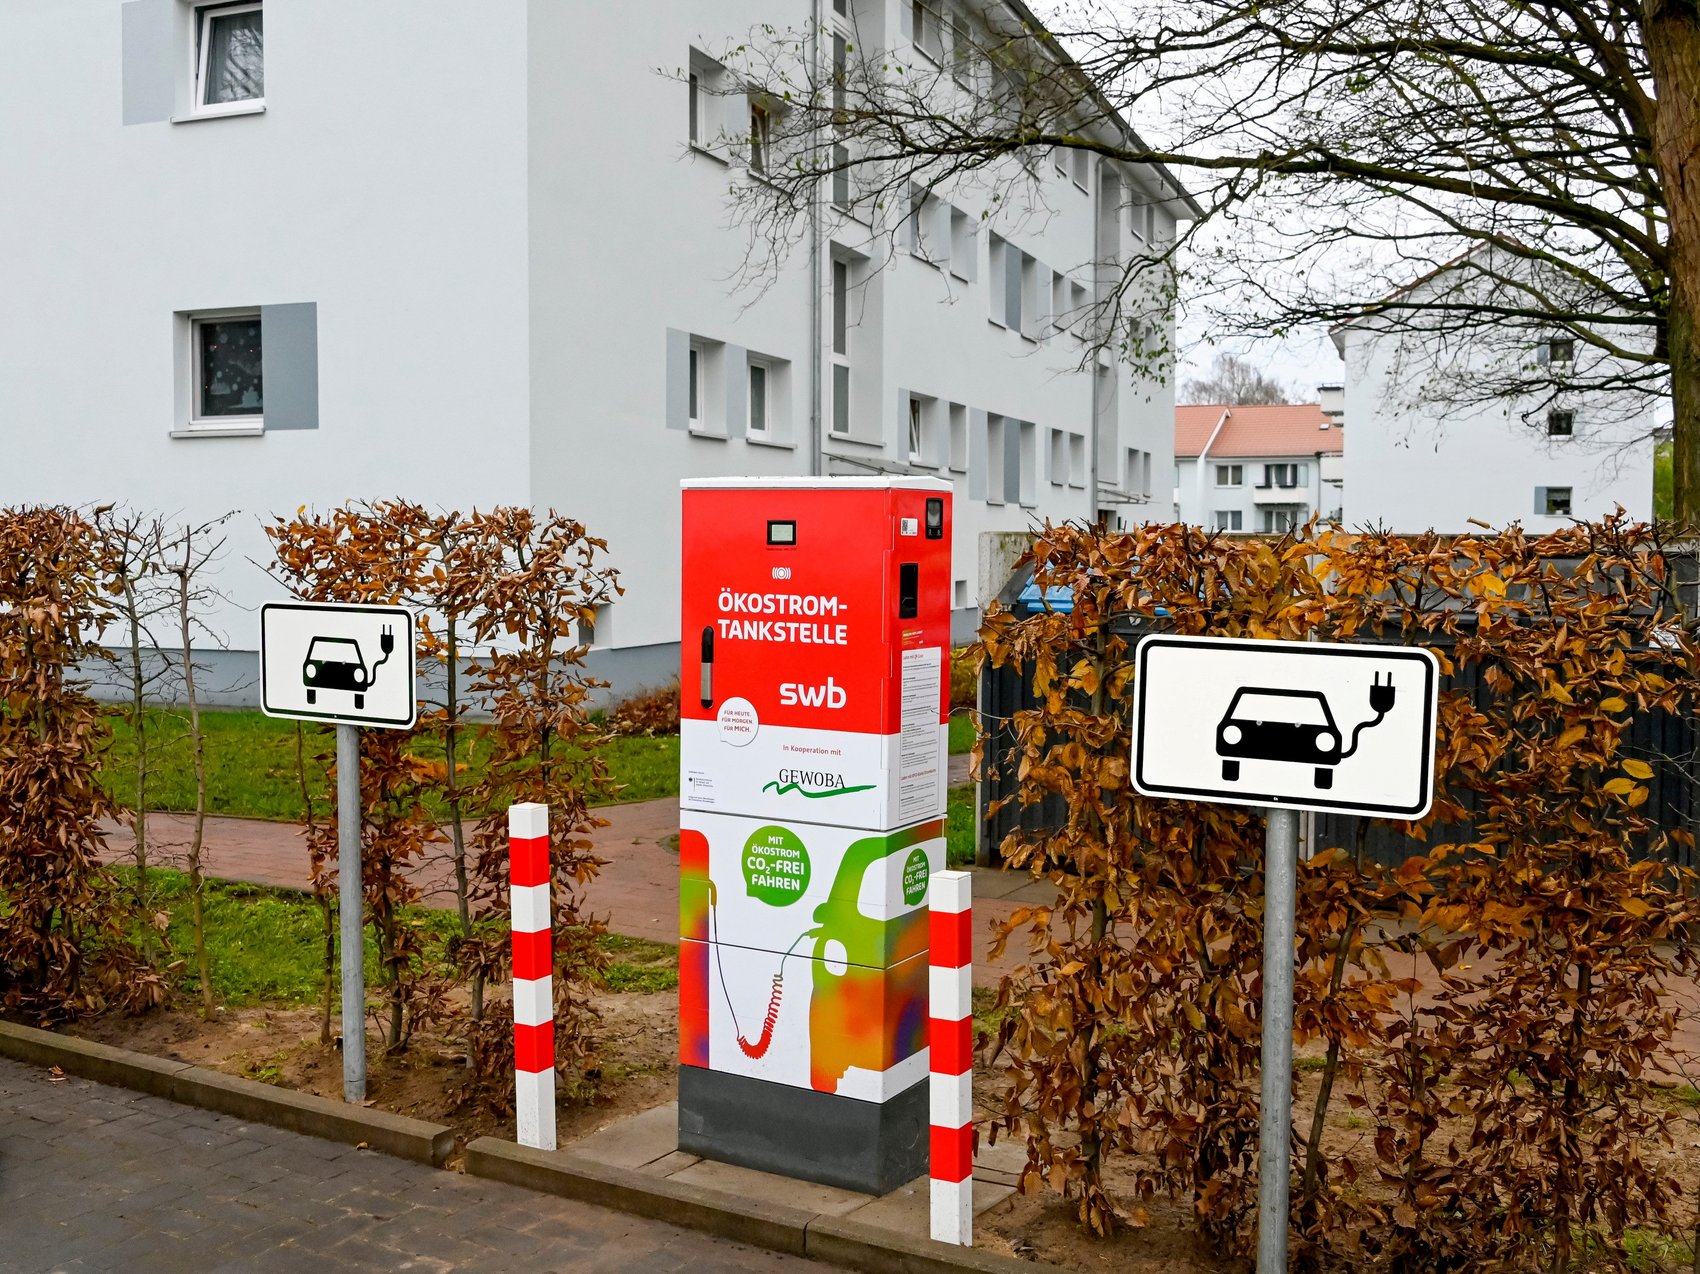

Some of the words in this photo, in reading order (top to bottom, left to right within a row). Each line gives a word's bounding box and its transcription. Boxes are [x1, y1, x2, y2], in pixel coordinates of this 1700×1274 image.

[718, 587, 848, 617] ÖKOSTROM-
[717, 619, 848, 645] TANKSTELLE
[779, 676, 847, 709] swb
[734, 725, 752, 733] MICH.
[790, 745, 829, 755] Kooperation
[779, 768, 846, 789] GEWOBA
[768, 835, 784, 846] MIT
[751, 843, 800, 859] ÖKOSTROM
[751, 873, 800, 891] FAHREN
